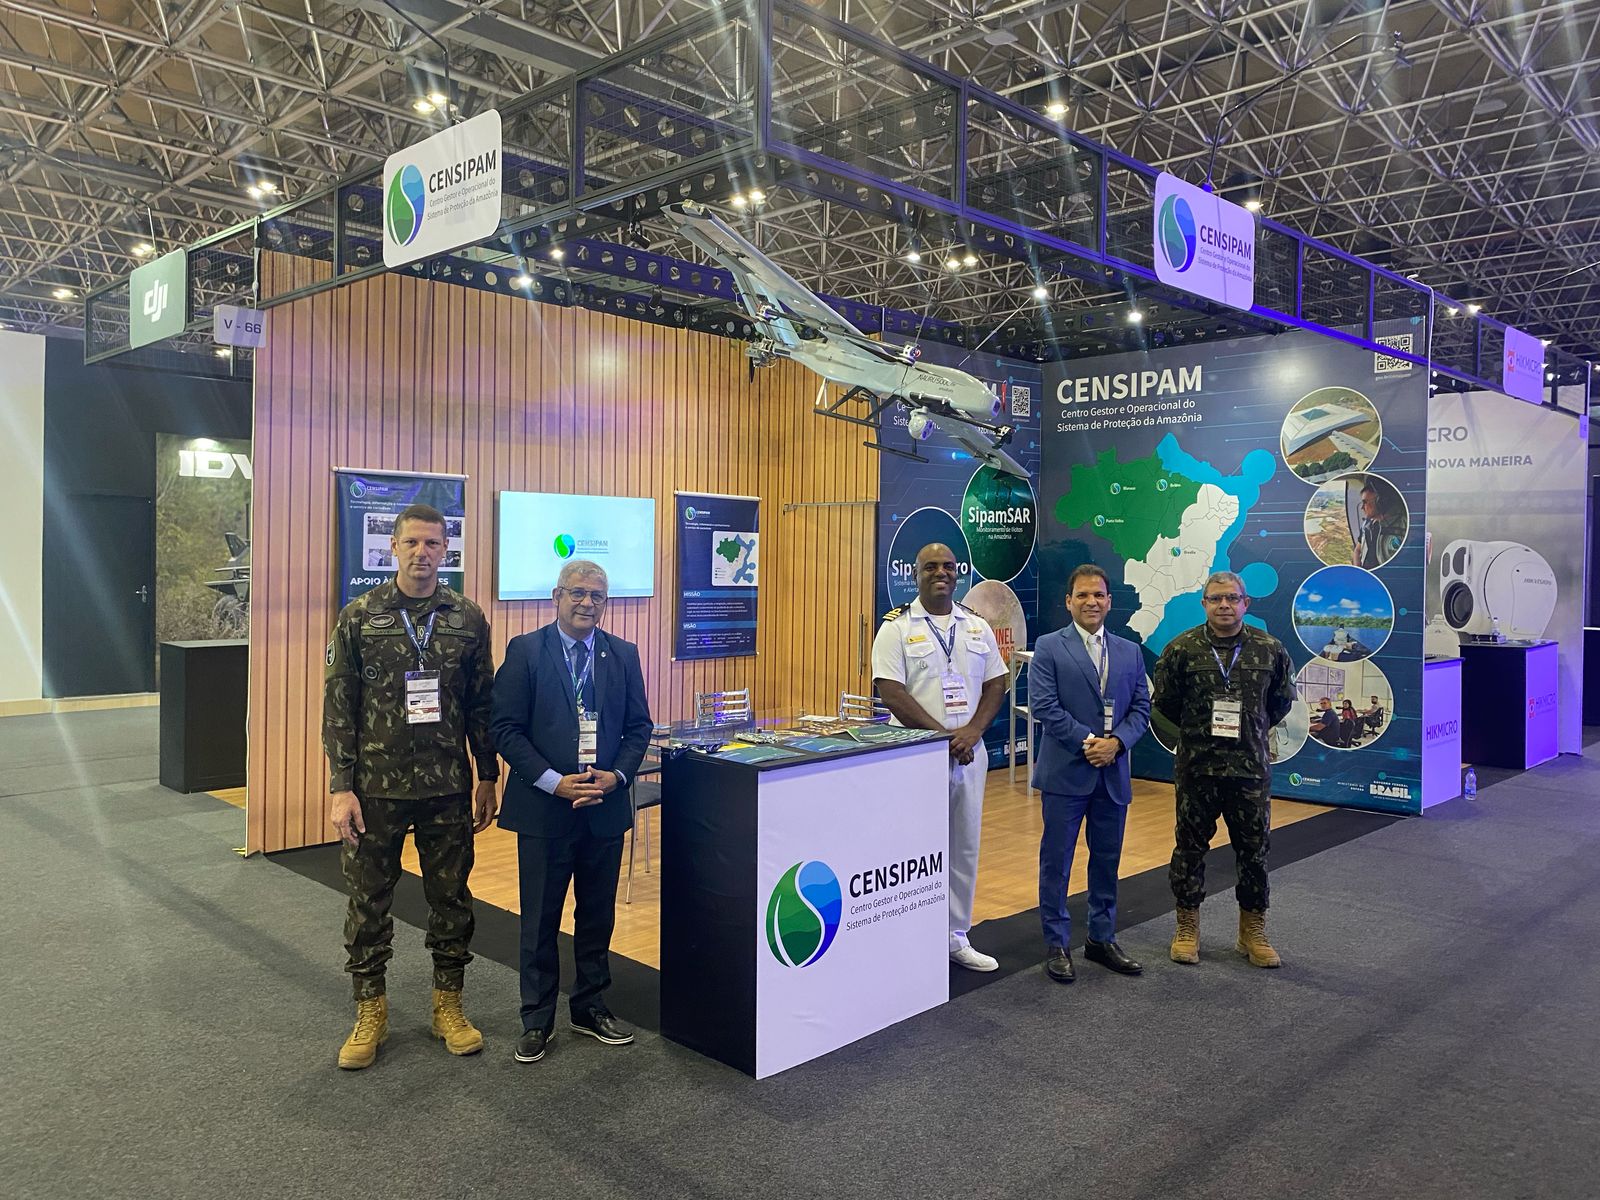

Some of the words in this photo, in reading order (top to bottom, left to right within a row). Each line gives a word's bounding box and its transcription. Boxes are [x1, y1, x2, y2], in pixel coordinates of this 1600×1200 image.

[429, 149, 496, 193] CENSIPAM
[430, 197, 443, 207] Centro
[444, 191, 458, 201] Gestor
[462, 179, 488, 196] Operacional
[427, 210, 443, 220] Sistema
[1200, 225, 1251, 260] CENSIPAM
[223, 318, 233, 330] V
[245, 322, 262, 334] 66
[1057, 365, 1202, 404] CENSIPAM
[1061, 408, 1089, 419] Centro
[1090, 406, 1118, 417] Gestor
[1120, 406, 1125, 414] e
[1127, 399, 1181, 415] Operacional
[1183, 398, 1196, 409] do
[1057, 421, 1089, 432] Sistema
[1091, 420, 1101, 429] de
[1103, 417, 1142, 429] Proteção
[1143, 415, 1155, 426] da
[1156, 412, 1202, 425] Amazônia
[1429, 457, 1466, 468] NOVA
[1469, 455, 1533, 467] MANEIRA
[968, 506, 1030, 528] SipamSAR
[350, 577, 381, 585] APOIO
[1426, 720, 1458, 740] HIKMICRO
[1370, 784, 1412, 800] BRASIL
[849, 851, 943, 898] CENSIPAM
[850, 901, 872, 915] Centro
[873, 894, 893, 908] Gestor
[899, 882, 934, 900] Operacional
[934, 880, 942, 891] do
[846, 917, 872, 931] Sistema
[873, 912, 881, 923] de
[882, 904, 909, 919] Proteção
[909, 901, 917, 912] da
[917, 893, 946, 909] Amazônia
